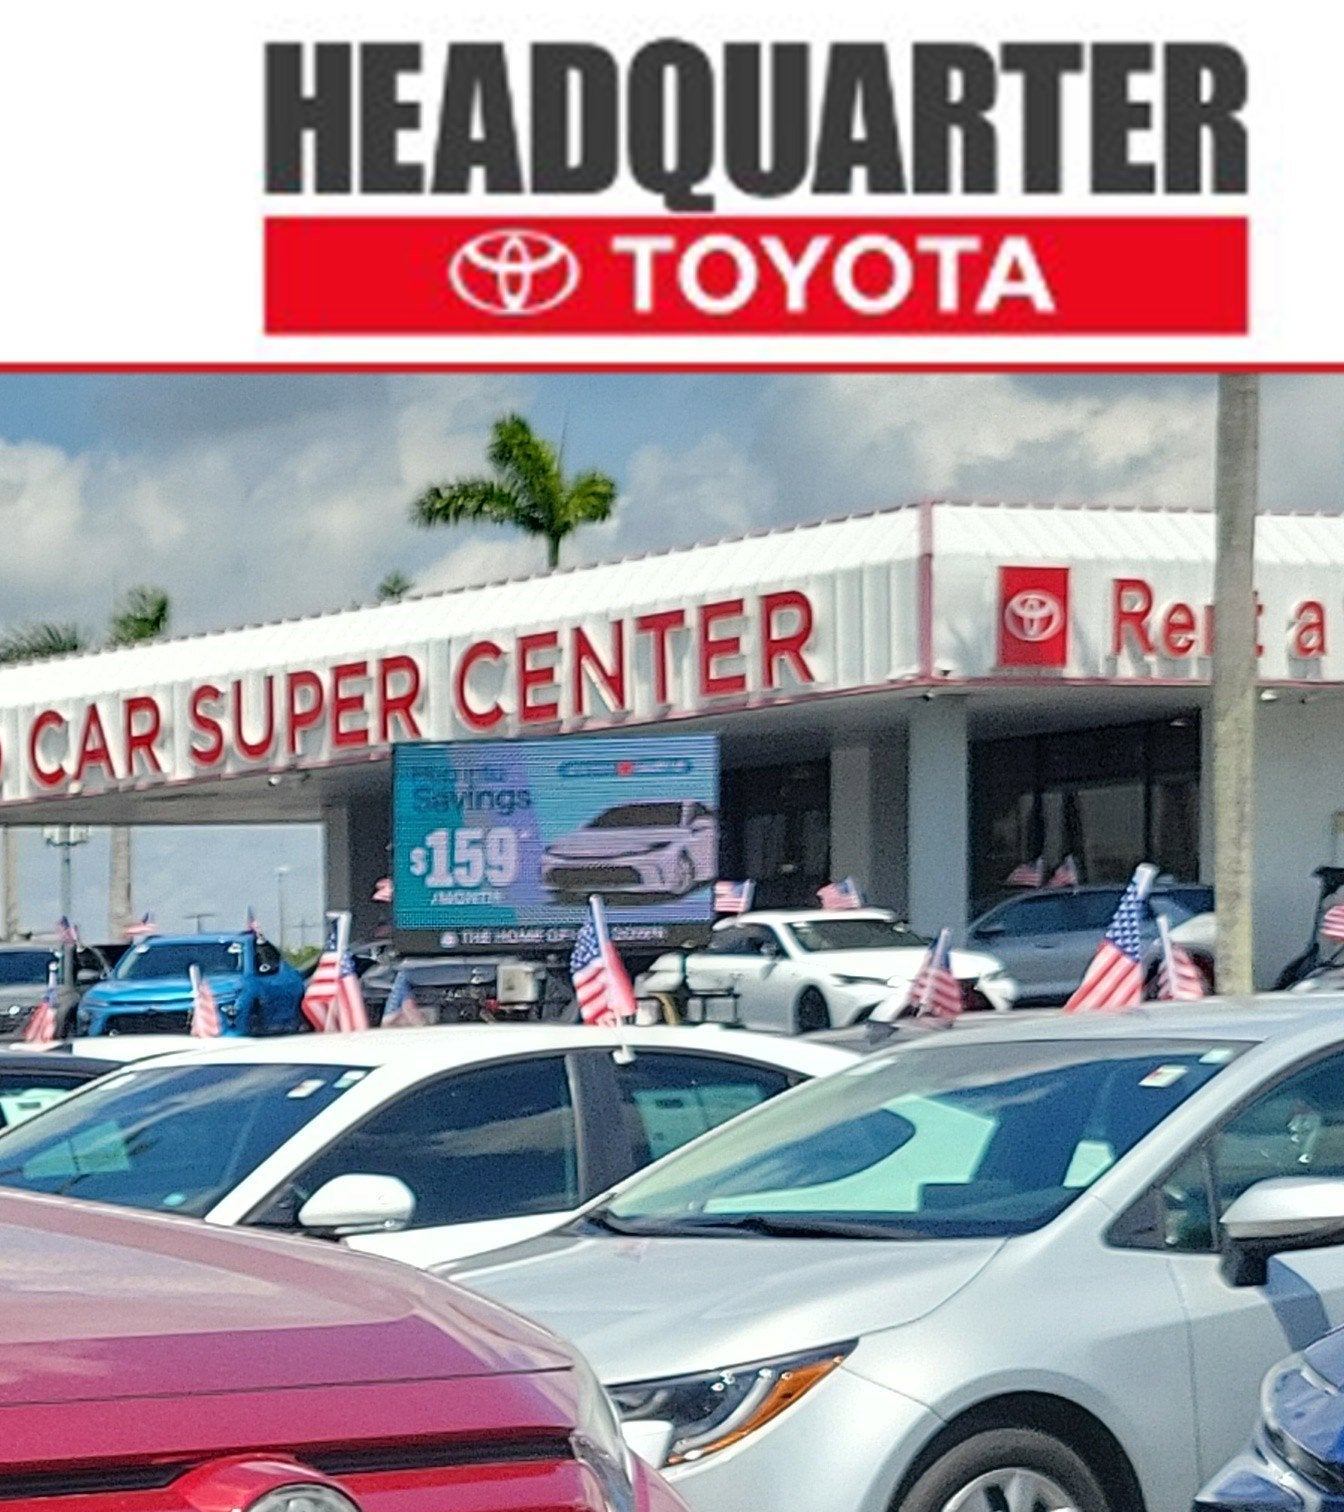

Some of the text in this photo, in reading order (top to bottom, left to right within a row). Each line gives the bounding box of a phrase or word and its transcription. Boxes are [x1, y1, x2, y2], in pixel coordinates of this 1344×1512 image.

[28, 696, 163, 788] CAR
[188, 654, 422, 767] SUPER
[454, 589, 816, 731] CENTER
